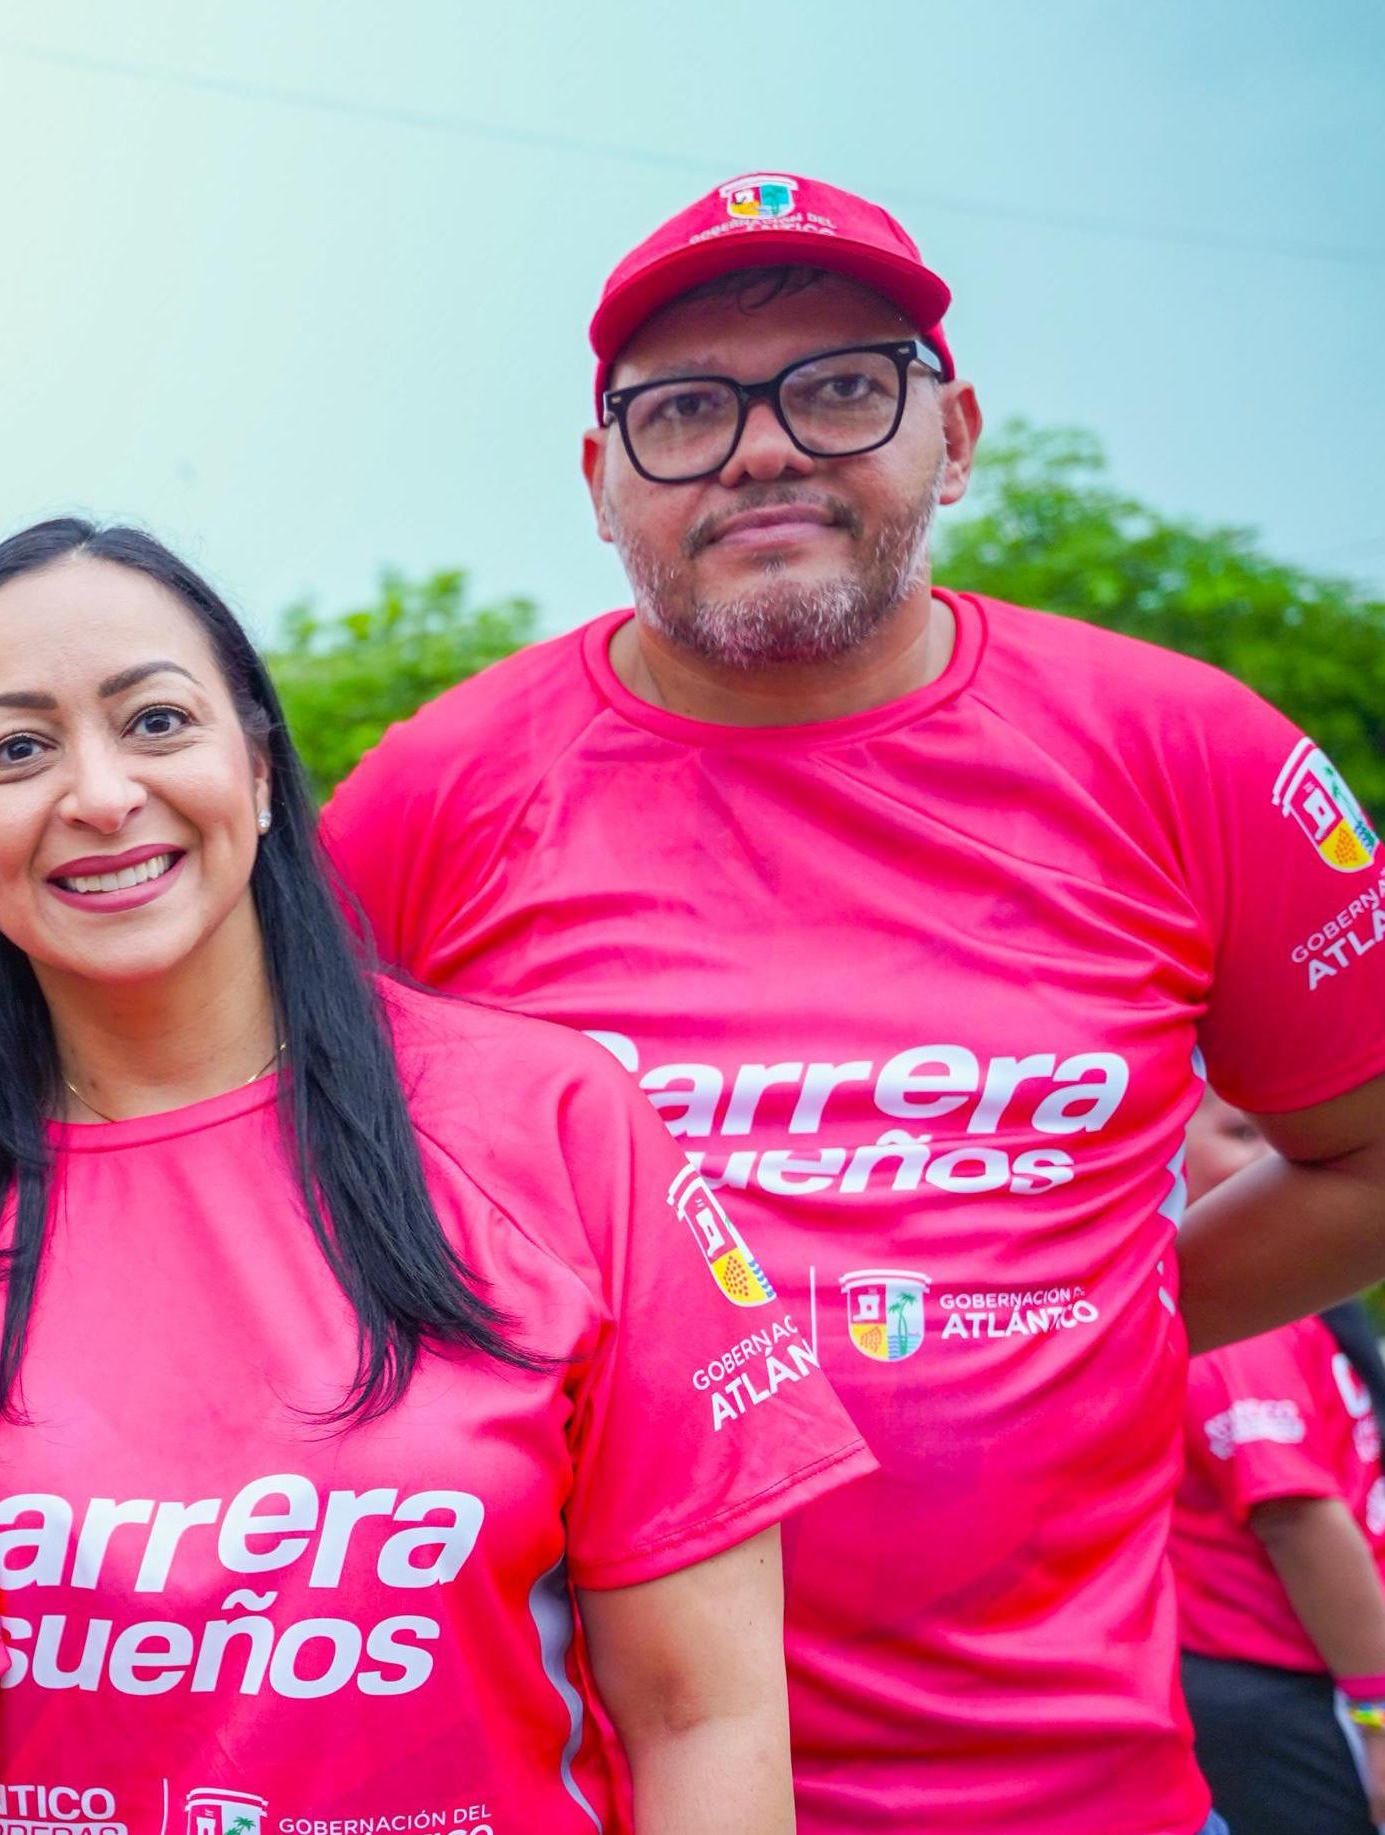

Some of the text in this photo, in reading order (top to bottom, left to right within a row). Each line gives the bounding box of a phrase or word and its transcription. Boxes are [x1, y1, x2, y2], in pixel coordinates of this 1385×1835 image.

[685, 1129, 1075, 1197] ueños
[692, 1315, 798, 1391] GOBERNAC
[711, 1338, 820, 1433] ATLÁN
[278, 1809, 447, 1835] GOBERNACIÓN
[453, 1803, 492, 1825] DEL
